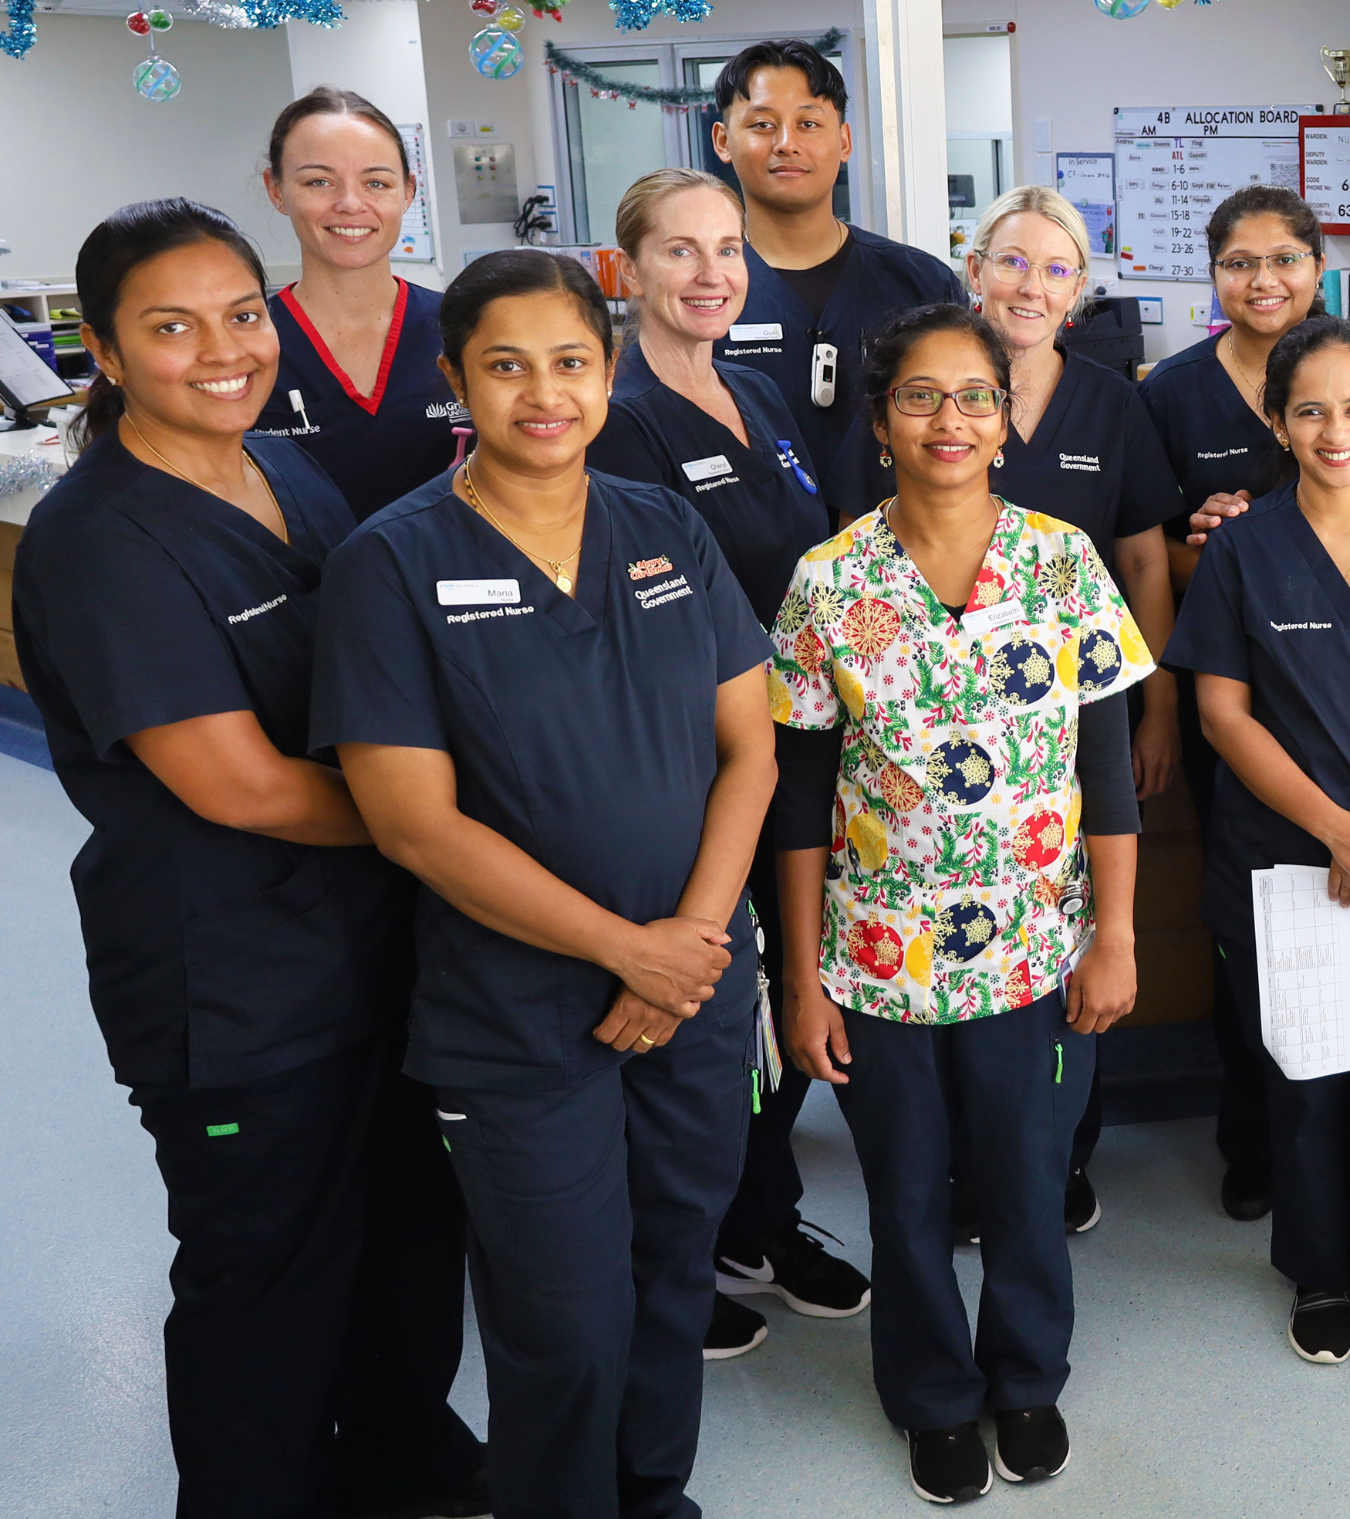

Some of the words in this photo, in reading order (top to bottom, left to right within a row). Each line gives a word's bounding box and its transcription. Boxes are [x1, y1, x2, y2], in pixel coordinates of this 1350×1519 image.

[1157, 112, 1171, 124] 4B
[1185, 111, 1254, 124] ALLOCATION
[1259, 111, 1299, 123] BOARD
[1141, 125, 1157, 135] AM
[1204, 125, 1219, 135] PM
[1174, 138, 1184, 148] TL
[1172, 151, 1184, 160] ATL
[1076, 157, 1098, 166] Service
[1173, 164, 1185, 174] 1-6
[1171, 180, 1189, 191] 6-10
[1172, 195, 1189, 205] 11-14
[1171, 210, 1190, 221] 15-18
[1171, 227, 1192, 238] 19-22
[1171, 243, 1194, 254] 23-26
[1171, 265, 1194, 276] 27-30
[724, 347, 761, 356] Registered
[762, 346, 783, 354] Nurse
[291, 425, 321, 436] Nurse
[1059, 452, 1100, 464] Queensland
[1197, 450, 1229, 459] Registered
[1229, 447, 1248, 455] Nurse
[1060, 461, 1101, 472] Government
[695, 477, 726, 493] Registered
[634, 574, 688, 600] Queensland
[487, 589, 513, 597] Maria
[640, 585, 694, 609] Government
[263, 594, 287, 611] Nurse
[446, 606, 504, 624] Registered
[504, 605, 534, 616] Nurse
[987, 607, 1020, 622] Elizabeth
[1309, 621, 1332, 629] Nurse
